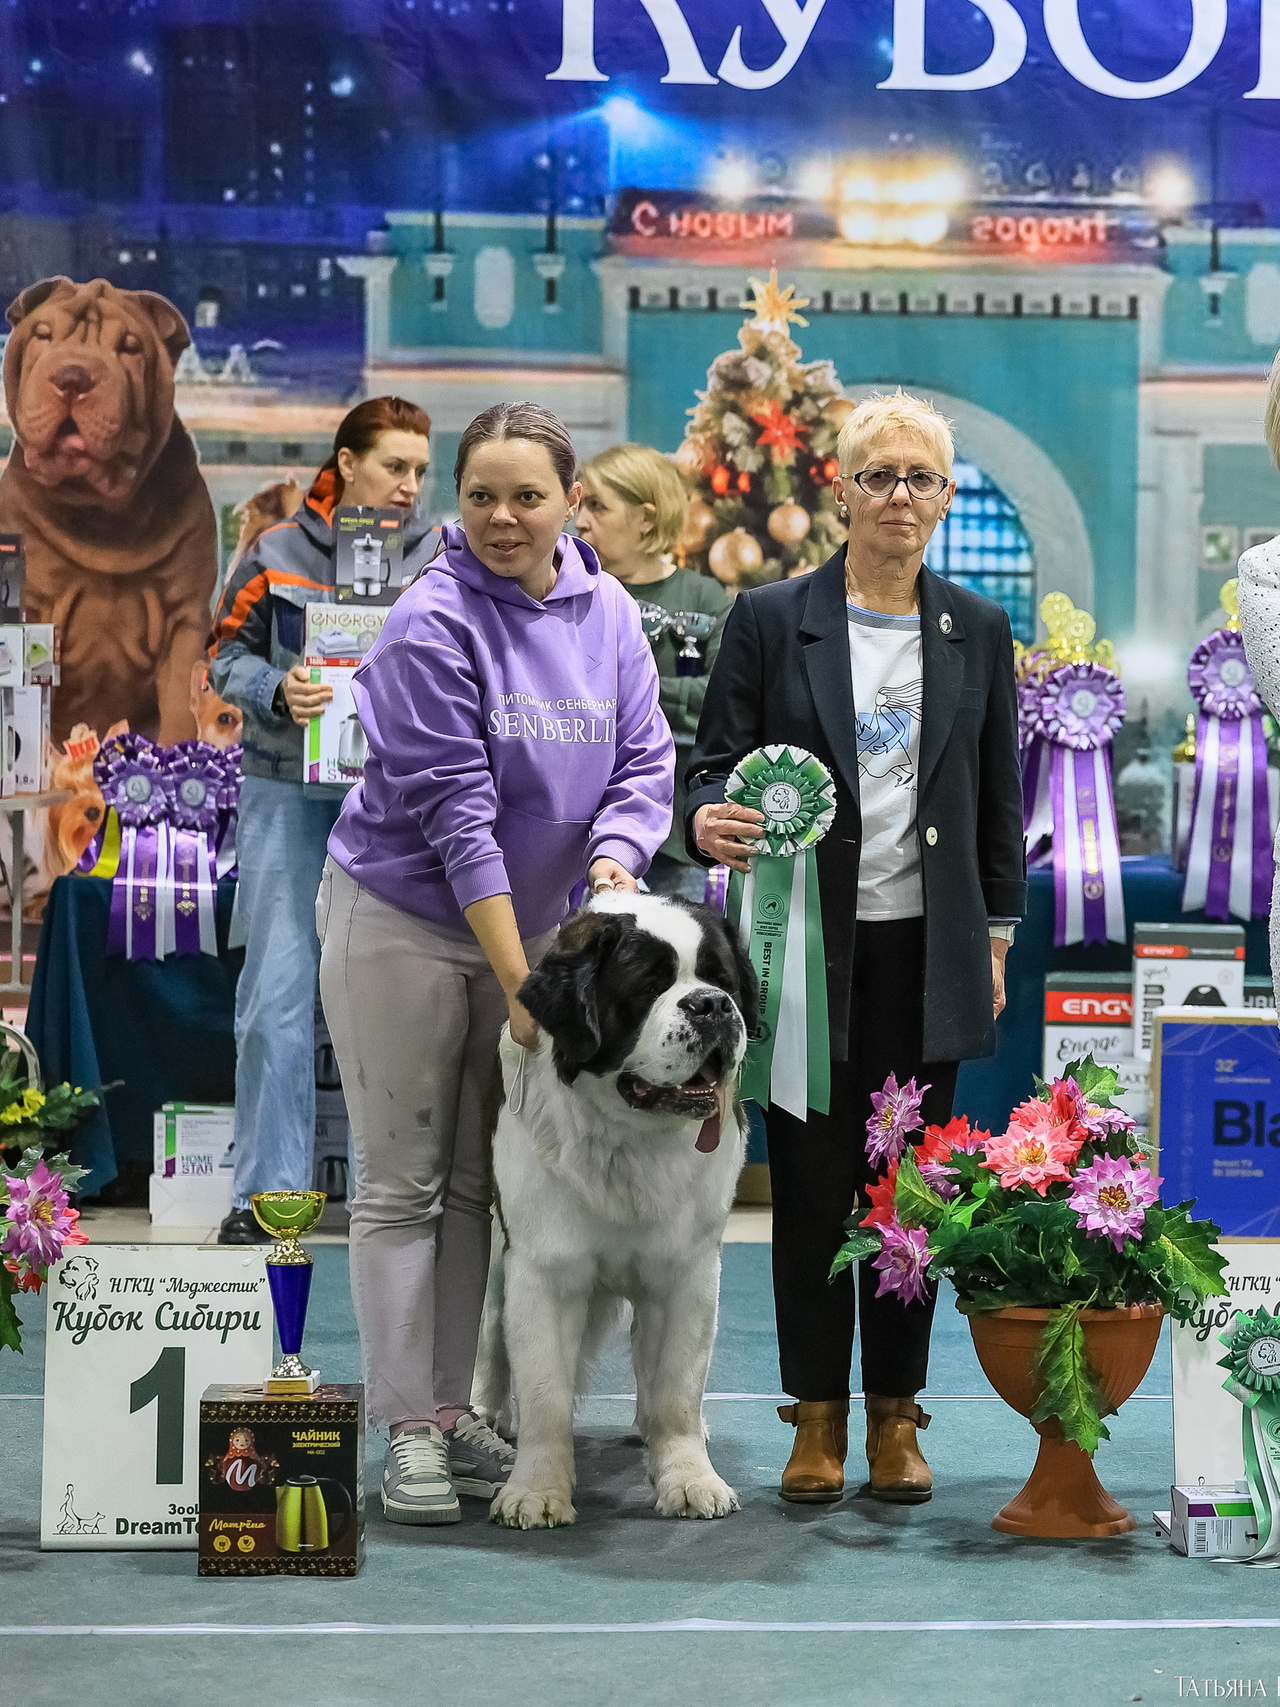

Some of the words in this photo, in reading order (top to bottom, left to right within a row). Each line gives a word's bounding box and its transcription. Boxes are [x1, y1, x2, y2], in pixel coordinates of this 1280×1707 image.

[762, 941, 773, 966] BEST
[761, 966, 771, 978] IN
[758, 979, 769, 1015] GROUP
[109, 1277, 155, 1297] НГКЦ
[1228, 1275, 1271, 1295] НГКЦ
[52, 1301, 144, 1346] Кубок
[154, 1300, 262, 1345] Сибири
[130, 1346, 186, 1485] 1
[291, 1428, 341, 1441] ЧАЙНИК
